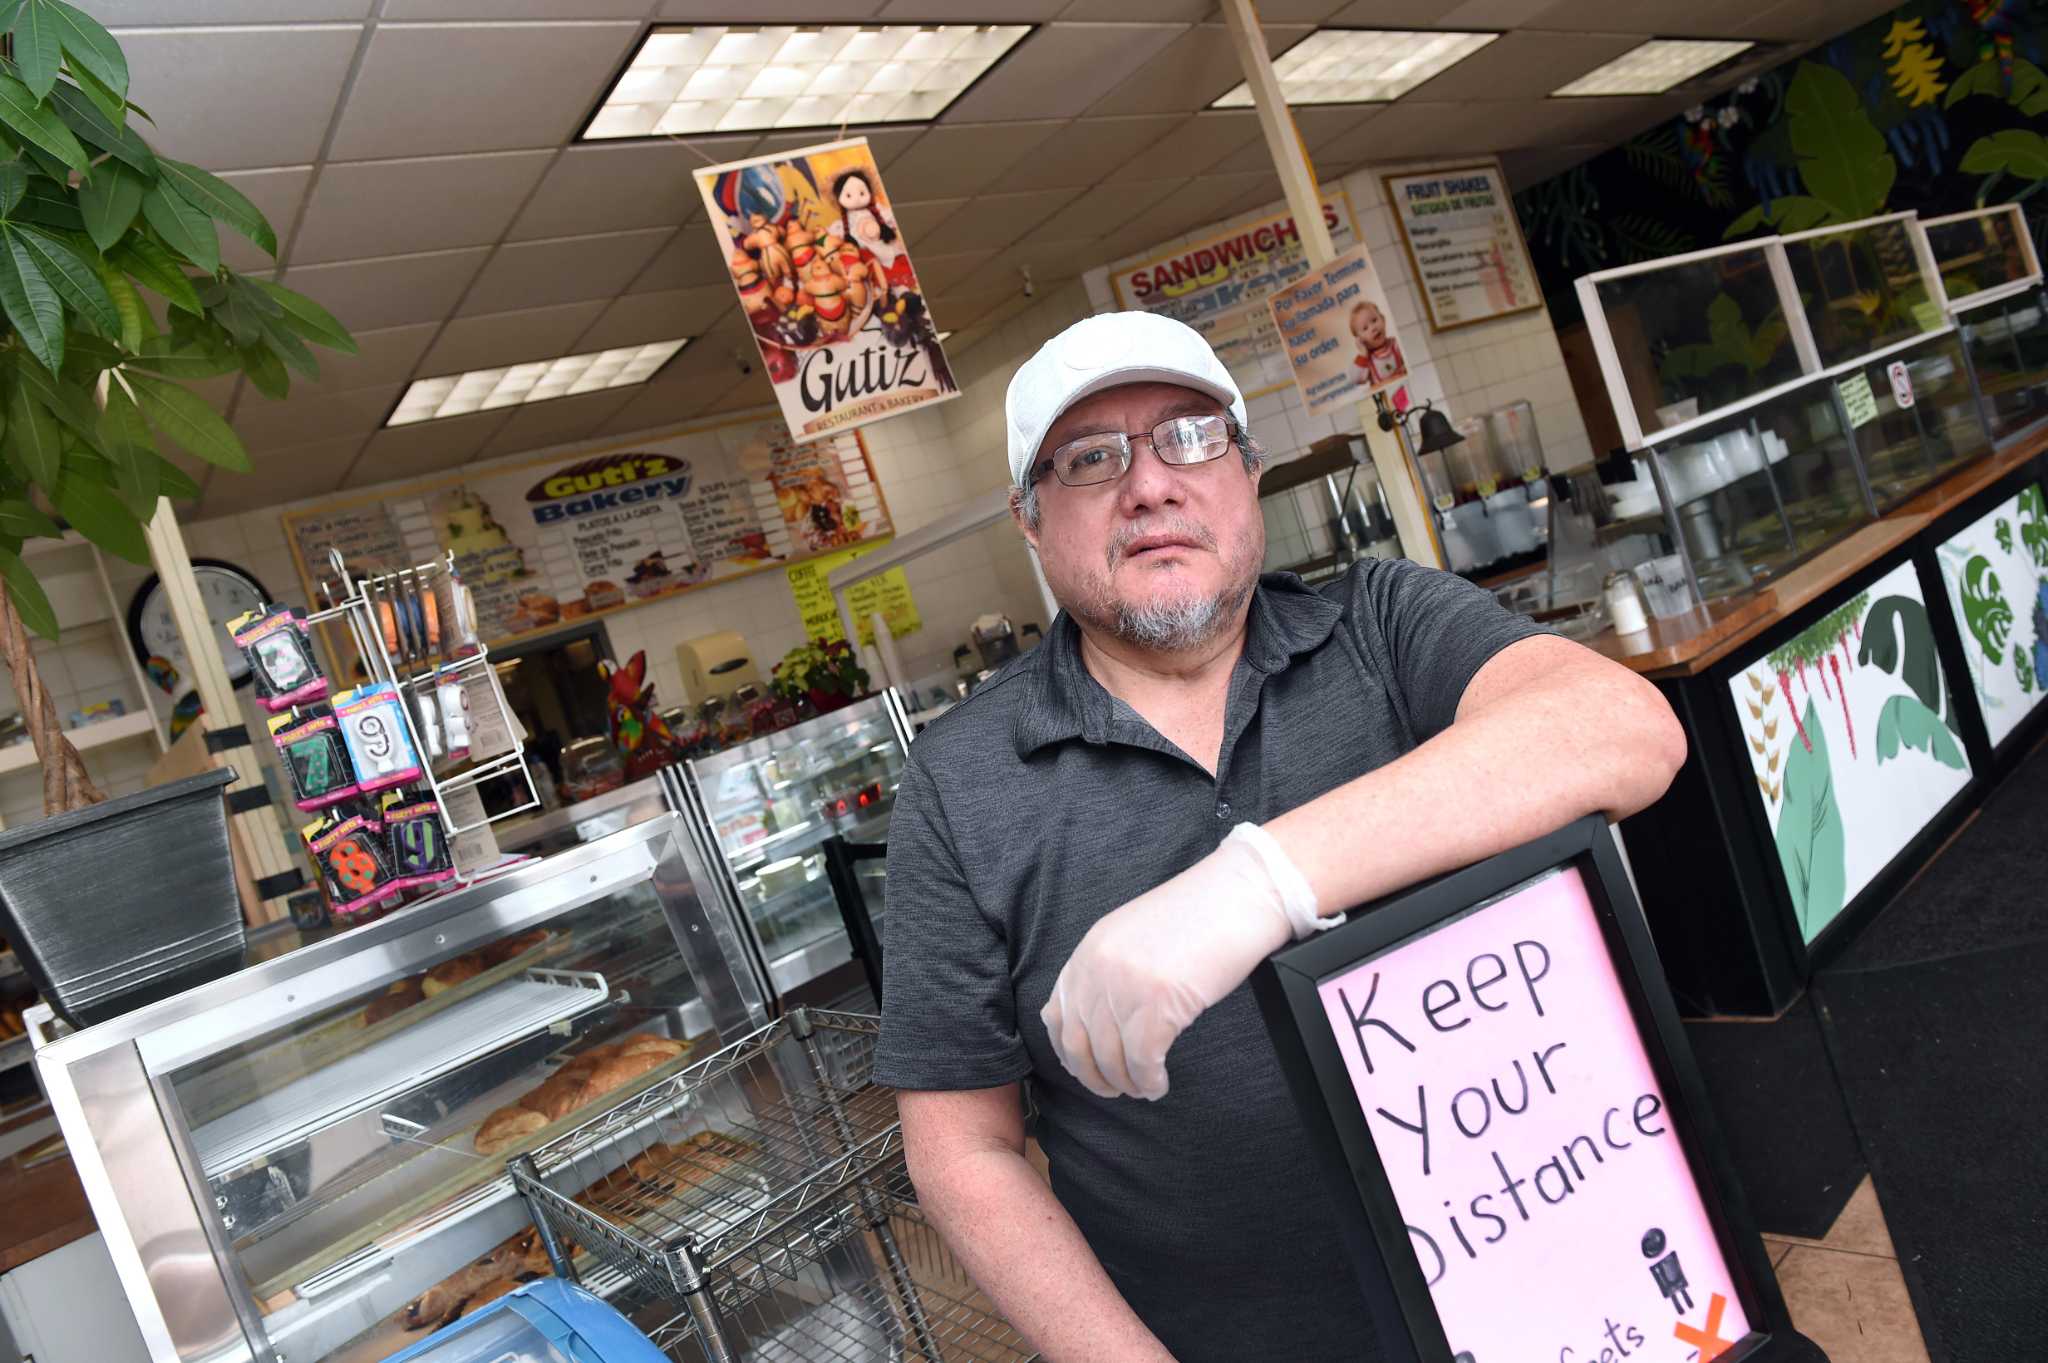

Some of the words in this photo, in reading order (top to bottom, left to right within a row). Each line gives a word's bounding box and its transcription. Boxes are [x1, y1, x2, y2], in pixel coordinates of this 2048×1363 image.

[1130, 204, 1339, 298] SANDWICHS
[800, 344, 927, 413] Gutiz
[816, 402, 876, 430] RESTAURANT
[532, 476, 688, 524] Bakery
[290, 734, 329, 796] 7
[1337, 939, 1551, 1075] Keep
